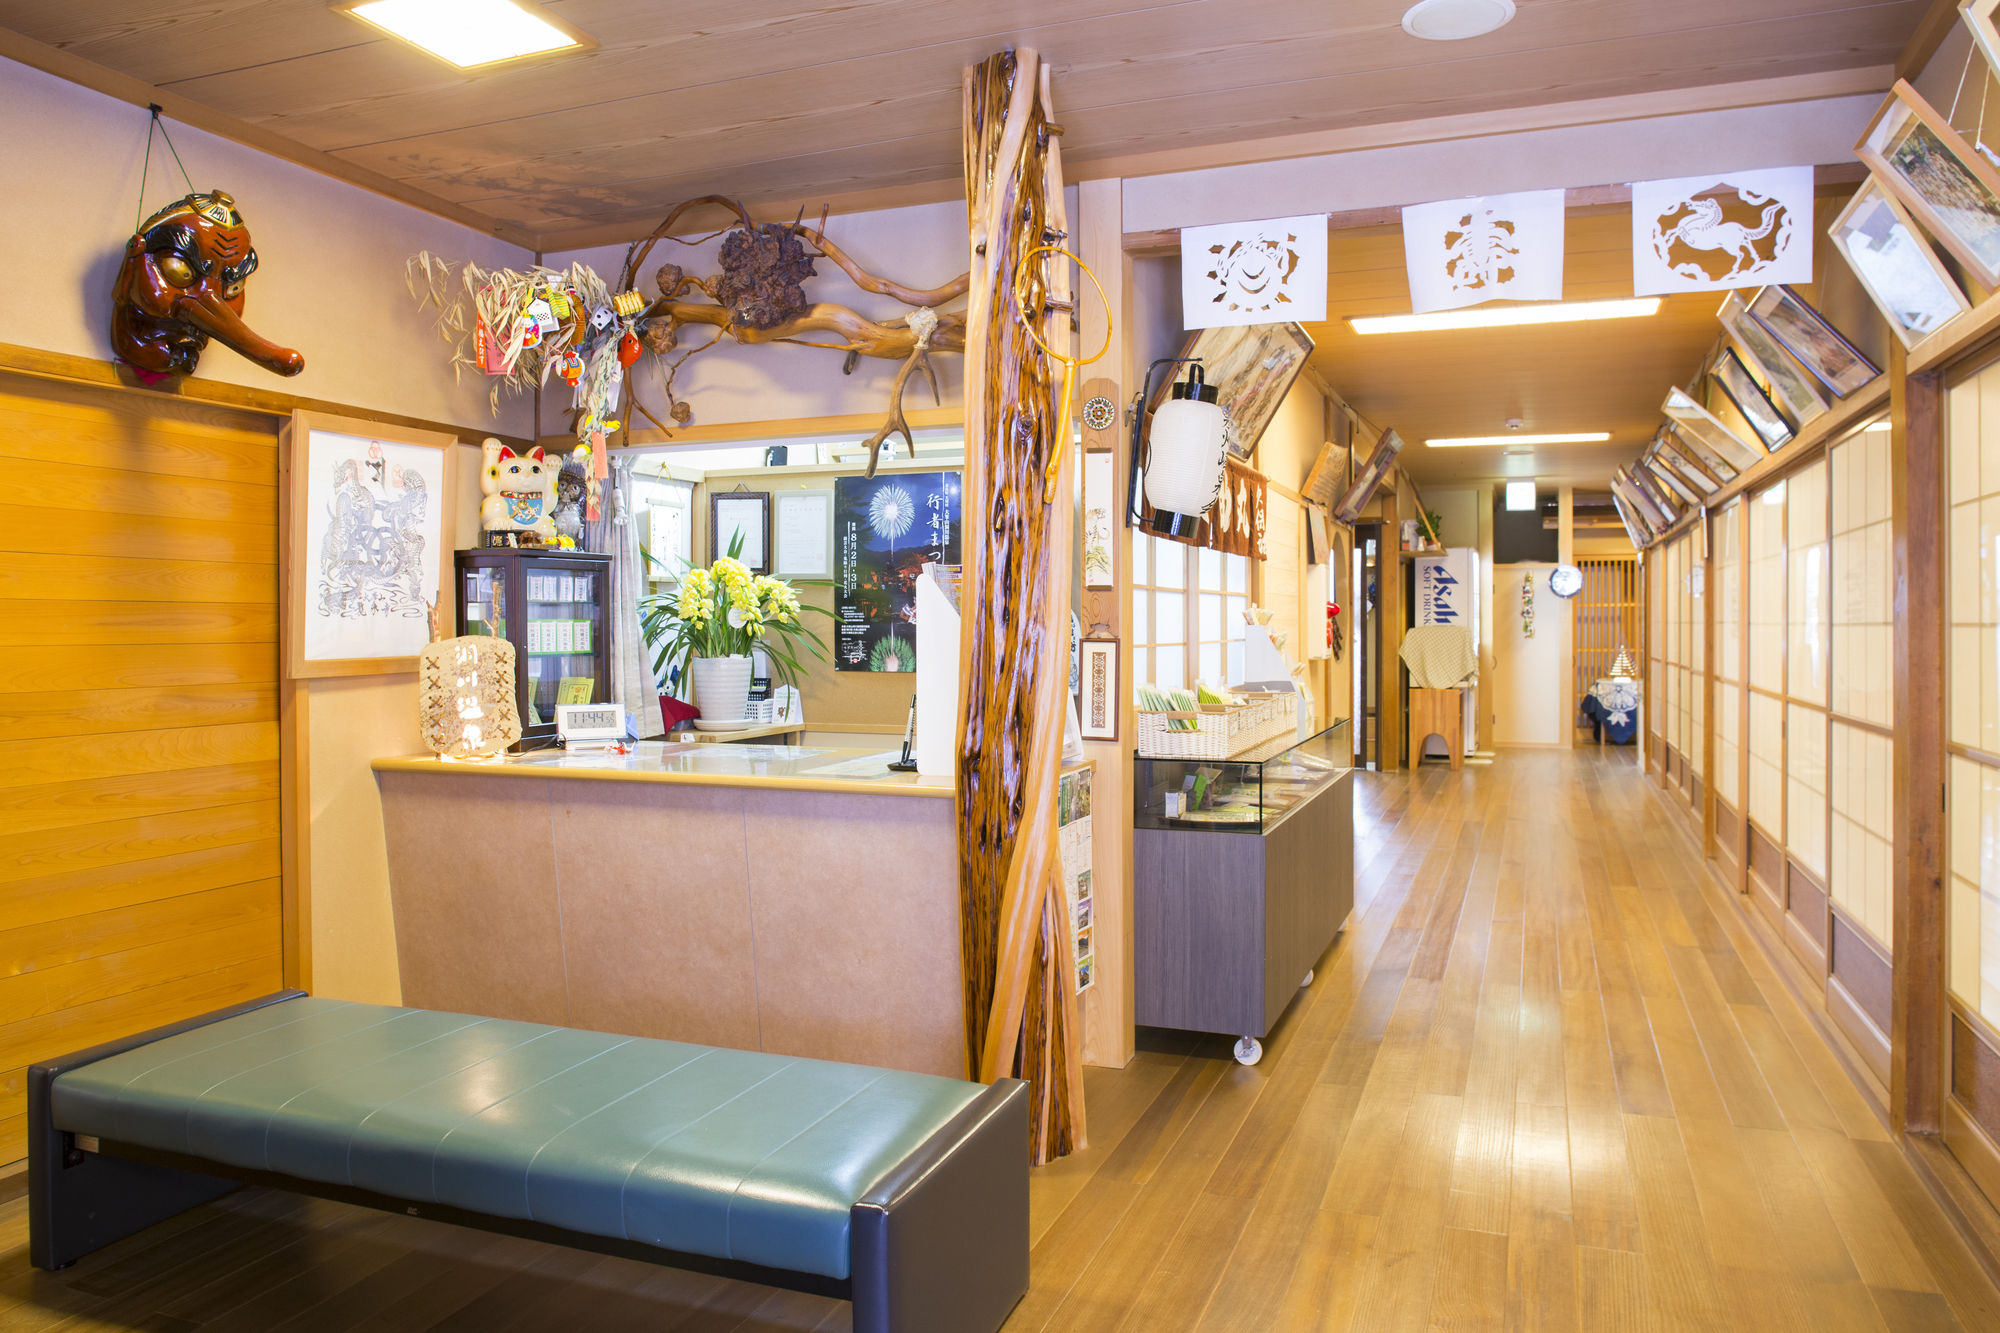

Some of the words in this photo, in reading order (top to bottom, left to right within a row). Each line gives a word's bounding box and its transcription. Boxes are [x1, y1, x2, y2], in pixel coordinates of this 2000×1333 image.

[926, 493, 943, 561] 行者まつ
[1423, 565, 1432, 590] SOFT
[1433, 565, 1459, 624] Asah
[573, 712, 604, 724] 11:44
